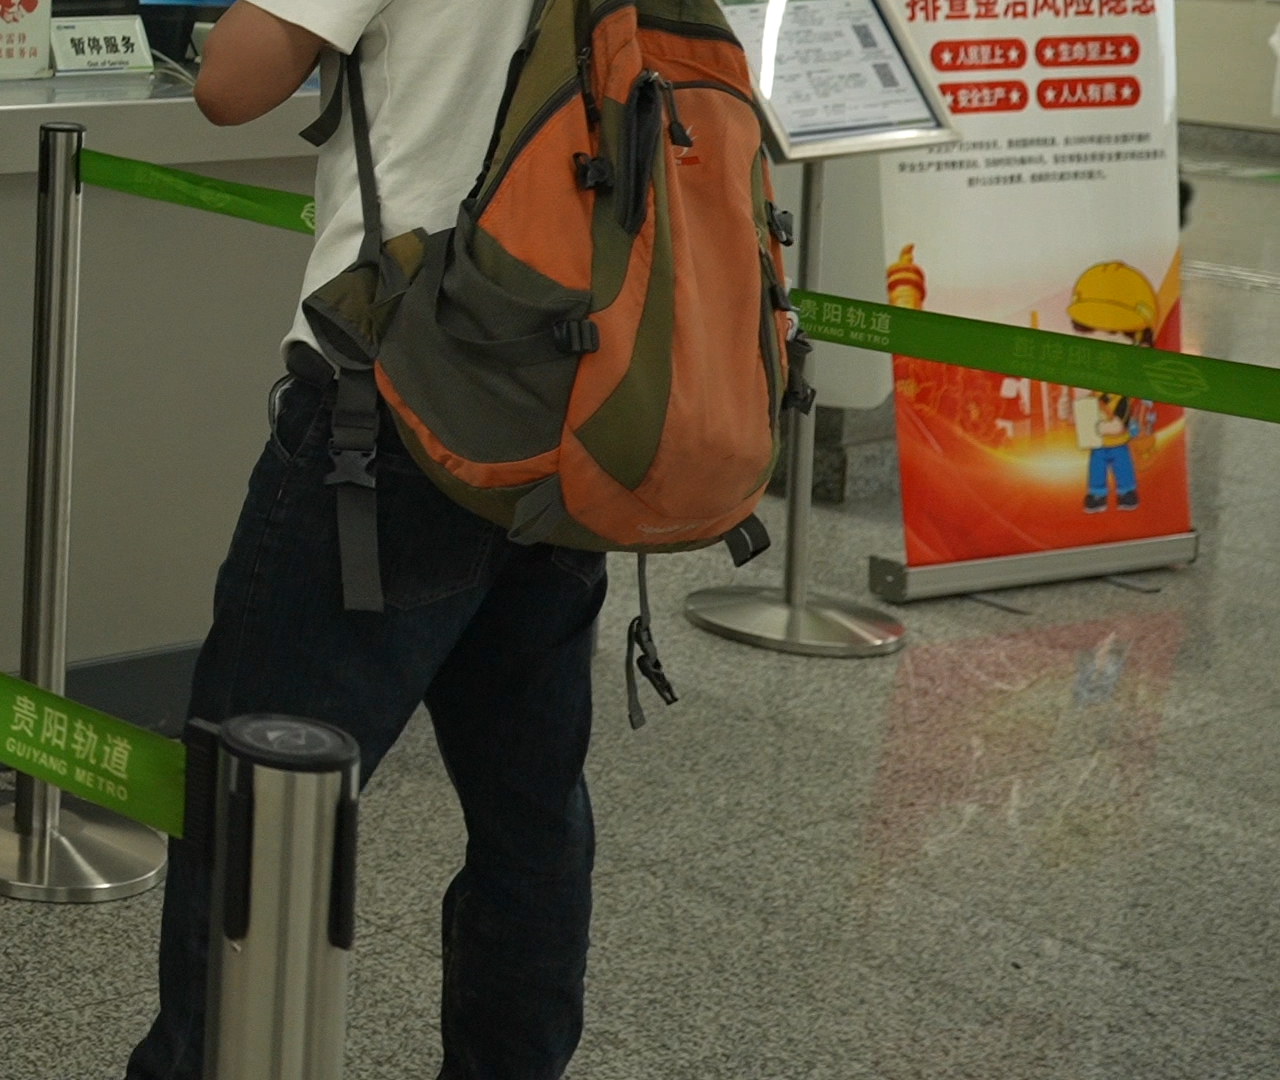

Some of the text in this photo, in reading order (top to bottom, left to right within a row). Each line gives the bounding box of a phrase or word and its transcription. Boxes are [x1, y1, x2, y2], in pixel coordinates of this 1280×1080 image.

[70, 34, 135, 57] 暂停服务
[1057, 42, 1117, 62] 生命至上
[957, 86, 1008, 108] 安全生产
[1059, 81, 1117, 103] 人人有责
[799, 298, 892, 335] 贵阳轨道
[849, 325, 890, 341] METRO
[9, 694, 134, 781] 贵阳轨道
[5, 735, 129, 802] GUIYANG METRO
